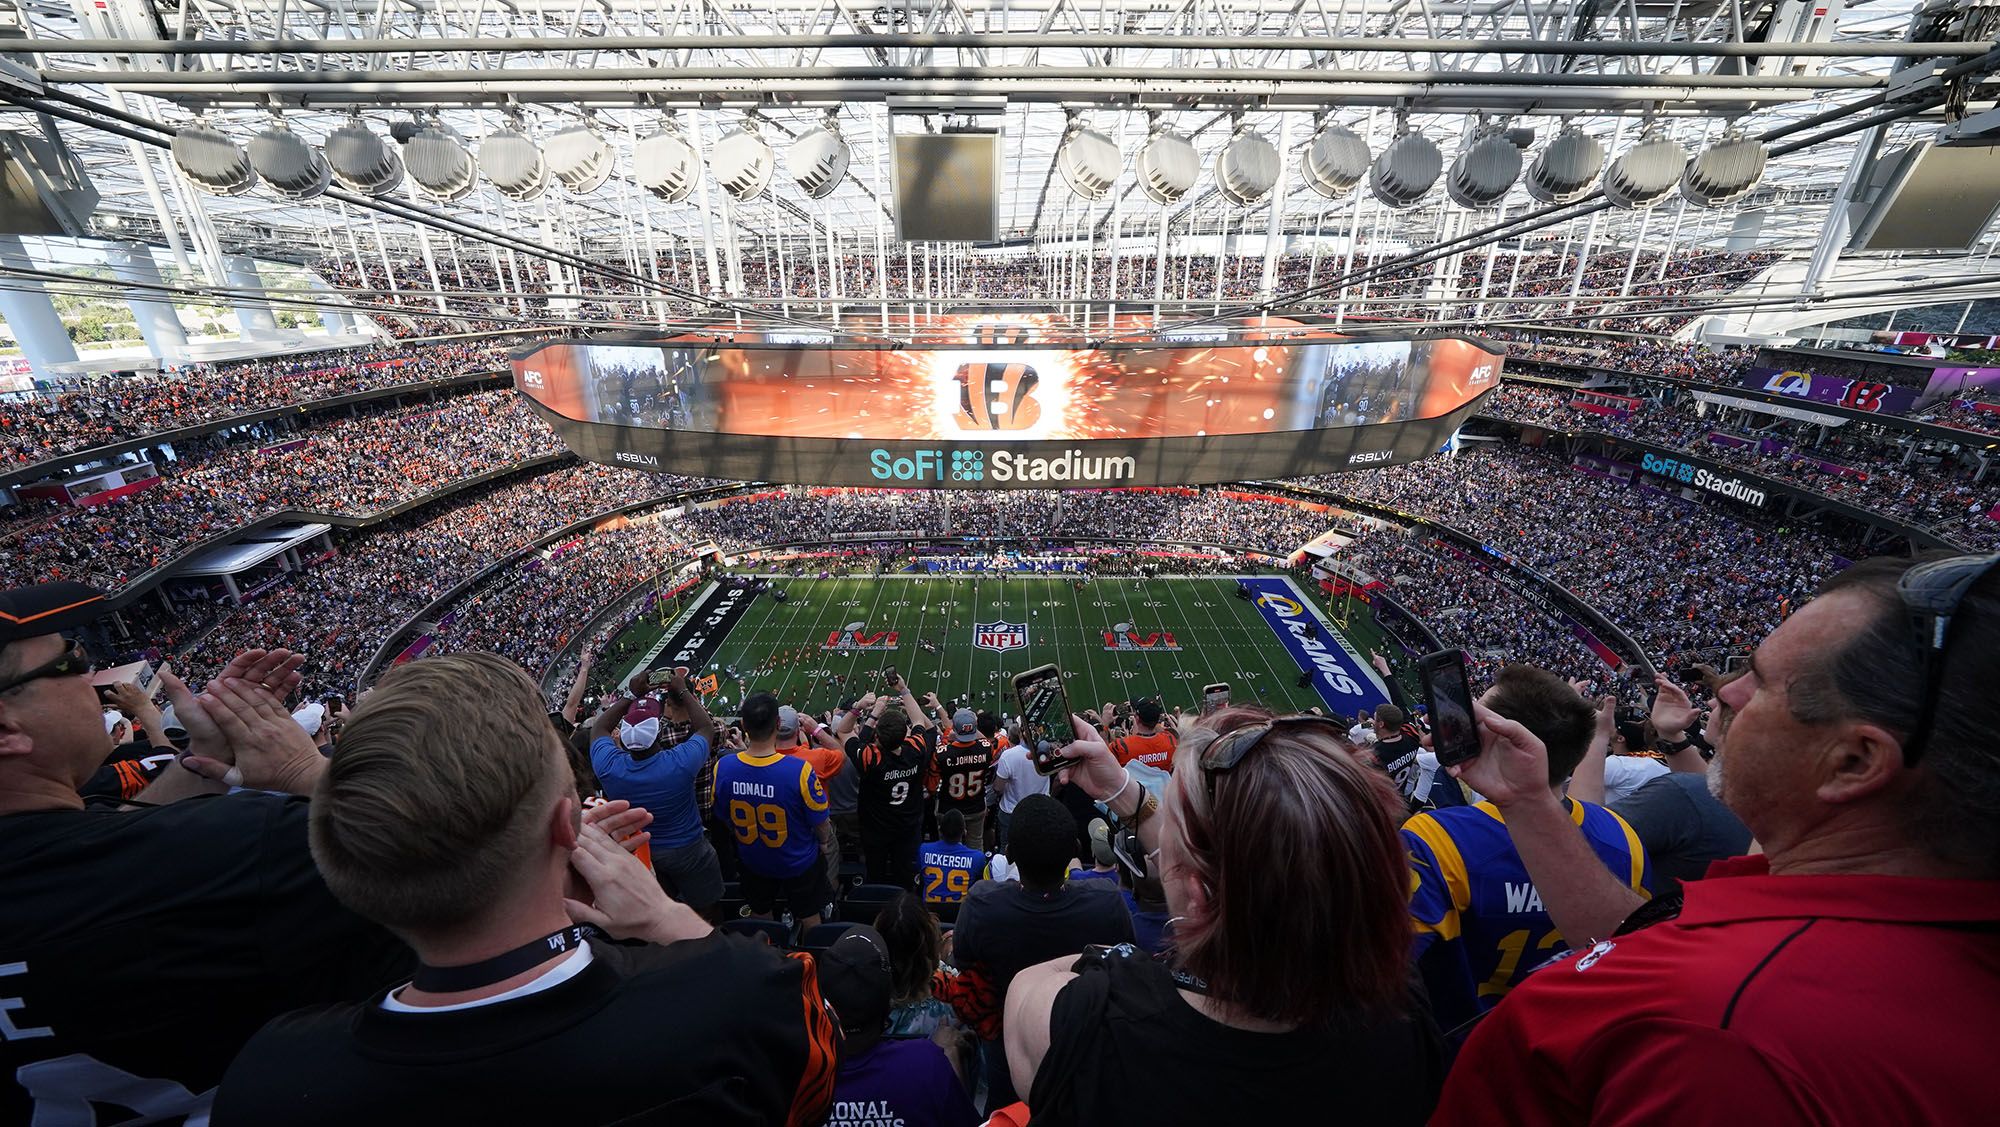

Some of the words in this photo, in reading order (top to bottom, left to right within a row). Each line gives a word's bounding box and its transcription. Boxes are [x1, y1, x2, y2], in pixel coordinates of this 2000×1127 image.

[524, 370, 542, 385] AFC
[1470, 365, 1491, 380] AFC
[616, 452, 658, 465] #SBLVI
[1349, 450, 1393, 464] #SBLVI
[870, 449, 944, 481] SoFi
[991, 450, 1136, 481] Stadium
[1641, 453, 1678, 477] SoFi
[1694, 469, 1765, 507] Stadium
[673, 588, 744, 661] BEGALS
[981, 633, 1022, 648] NFL
[808, 669, 831, 678] 20
[1111, 671, 1134, 679] 30
[1172, 671, 1195, 679] 20
[1234, 671, 1256, 679] 10
[955, 754, 987, 767] JOHNSON
[1138, 752, 1168, 764] BURROW
[1387, 750, 1417, 773] BURROW
[884, 765, 918, 781] BURROW
[733, 781, 774, 798] DONALD
[949, 770, 984, 800] 85
[889, 781, 910, 805] 9
[730, 799, 787, 848] 99
[924, 852, 973, 869] DICKERSON
[923, 866, 970, 902] 29
